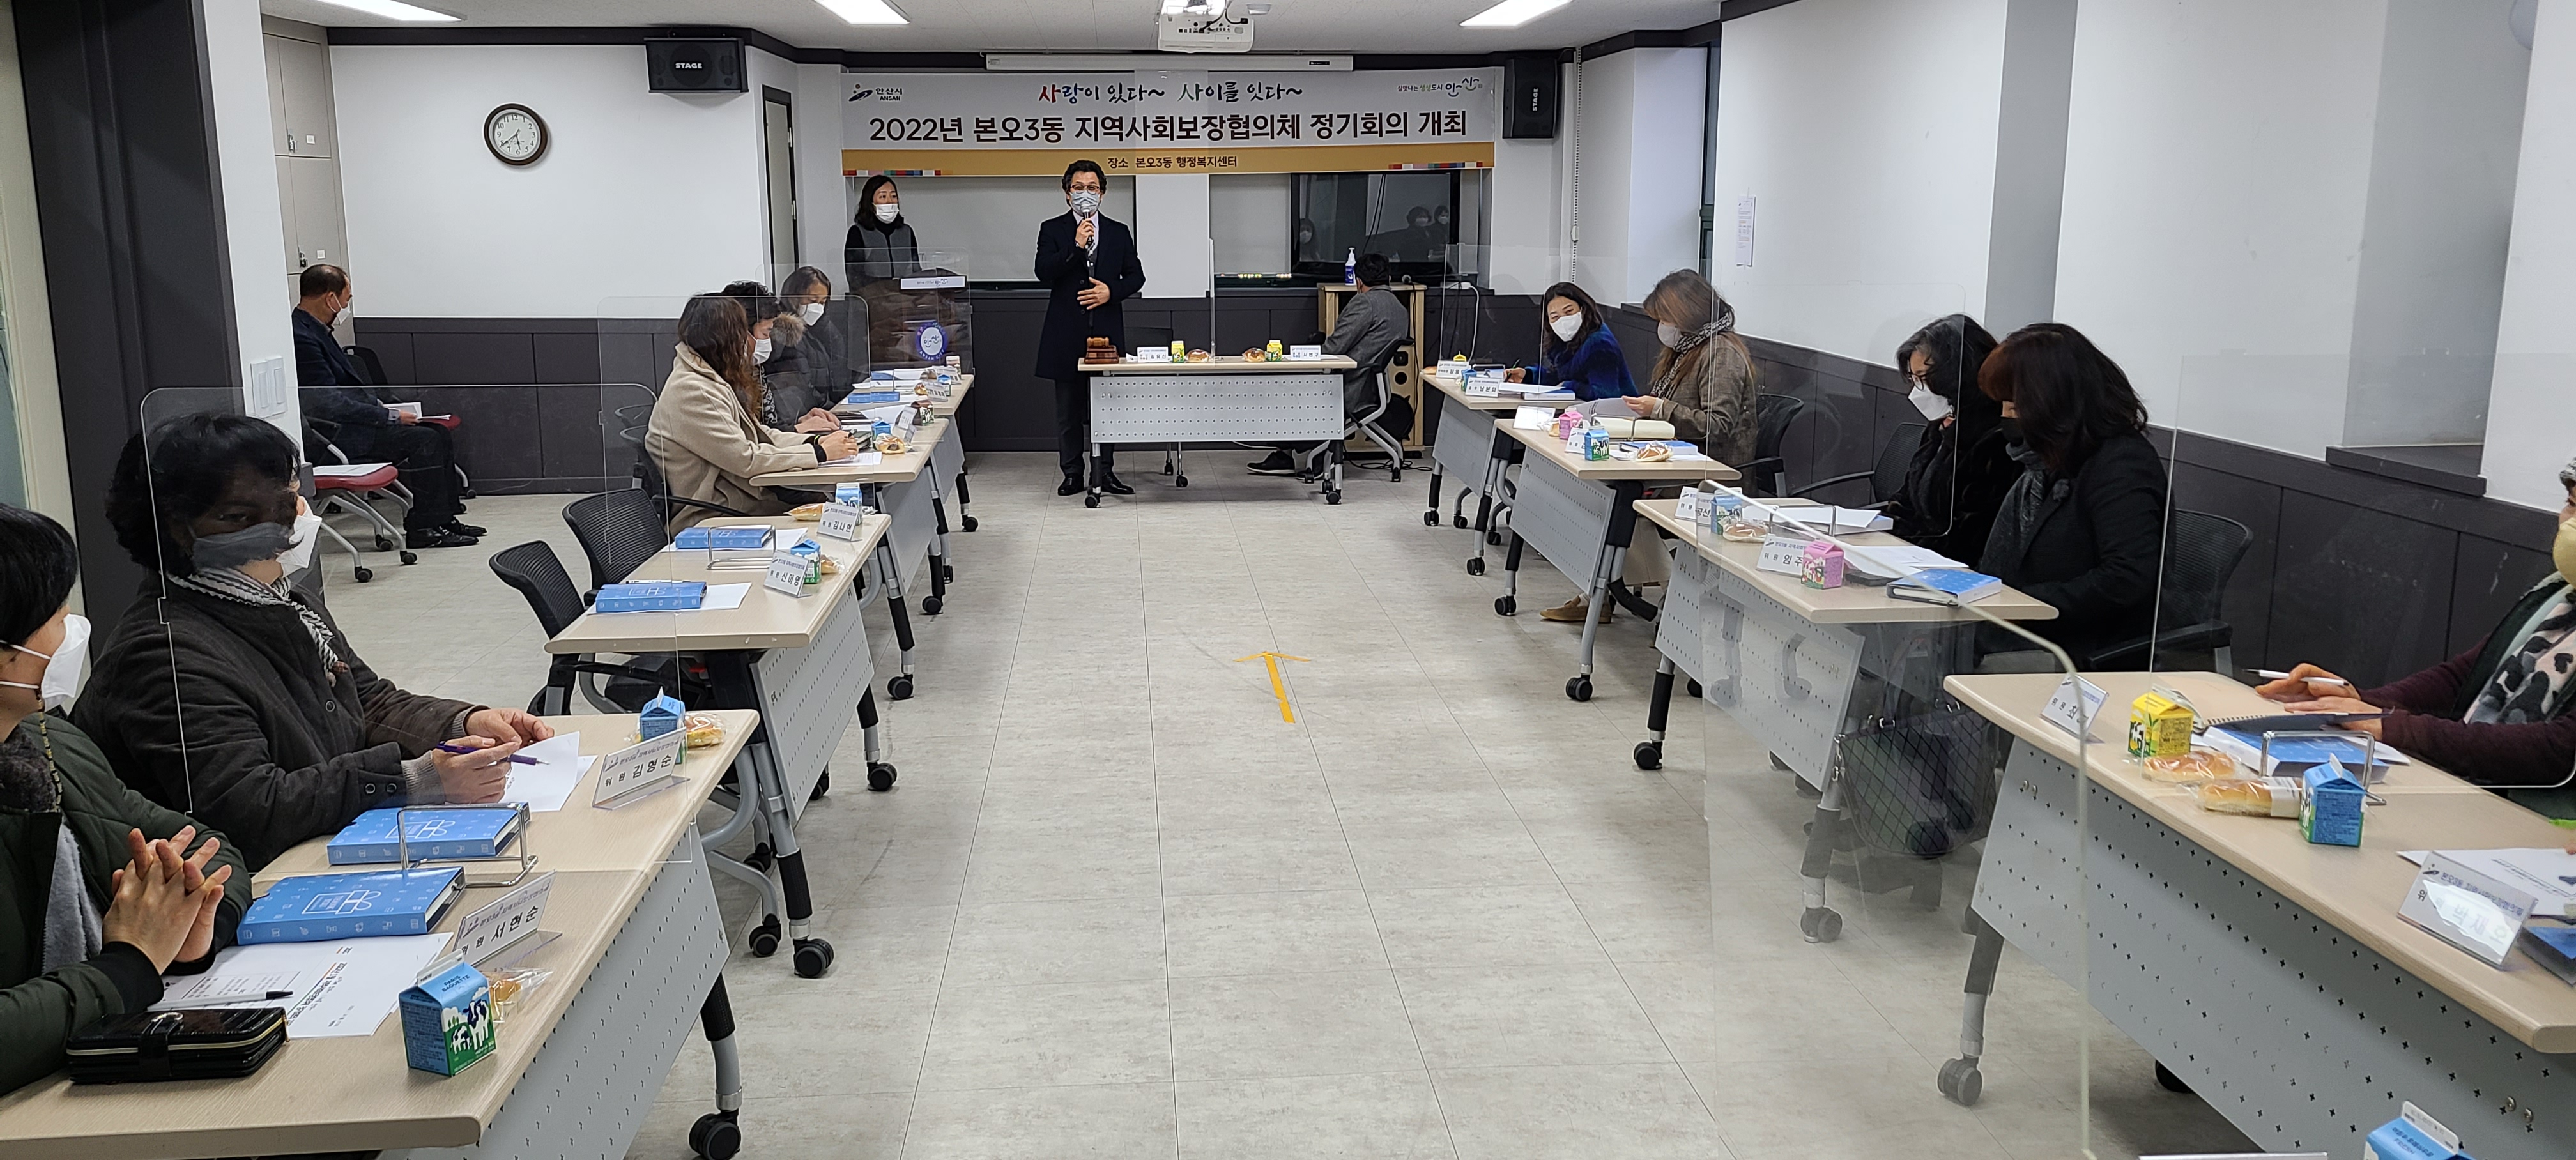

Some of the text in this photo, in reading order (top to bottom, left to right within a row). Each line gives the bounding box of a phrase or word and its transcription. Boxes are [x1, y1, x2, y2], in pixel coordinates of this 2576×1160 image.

[1038, 82, 1099, 104] 사랑이
[1177, 81, 1239, 103] 사이를
[1420, 84, 1443, 92] 생생도시
[870, 110, 1466, 143] 2022년 본오3동 지역사회보장협의체 정기회의 개최
[1107, 156, 1238, 169] 장소 본오3동 행정복지센터
[632, 754, 672, 779] 김형순
[490, 905, 539, 942] 서현순
[441, 974, 470, 992] BAGUETTE
[443, 975, 461, 986] PARIS
